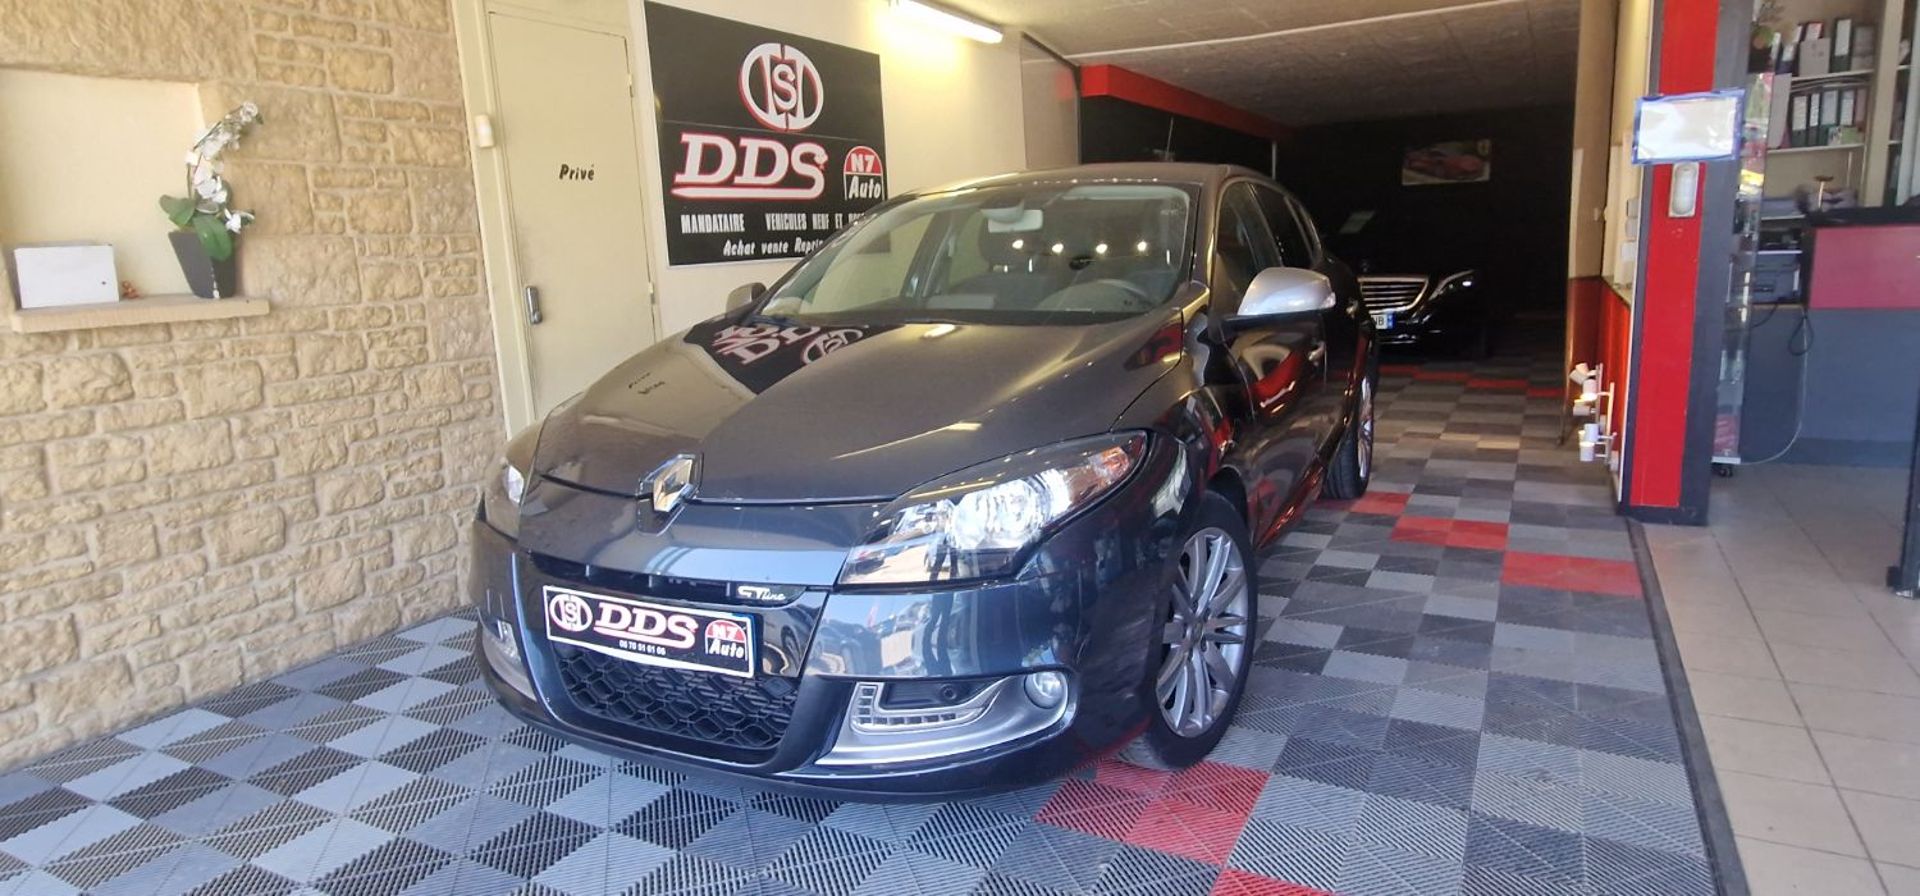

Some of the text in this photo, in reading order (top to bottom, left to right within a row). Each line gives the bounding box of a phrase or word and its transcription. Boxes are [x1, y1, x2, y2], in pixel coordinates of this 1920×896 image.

[559, 163, 595, 181] Privé
[671, 132, 828, 199] DDS
[850, 153, 875, 173] N7
[849, 175, 881, 199] Auto
[680, 213, 745, 234] MANDATAIRE
[765, 212, 807, 231] VEHICULES
[812, 213, 830, 230] NEUF
[835, 213, 843, 230] ET
[723, 239, 756, 256] Achat
[761, 240, 789, 255] vente
[593, 602, 699, 649] DDS
[712, 623, 738, 640] N7
[709, 638, 744, 659] Auto
